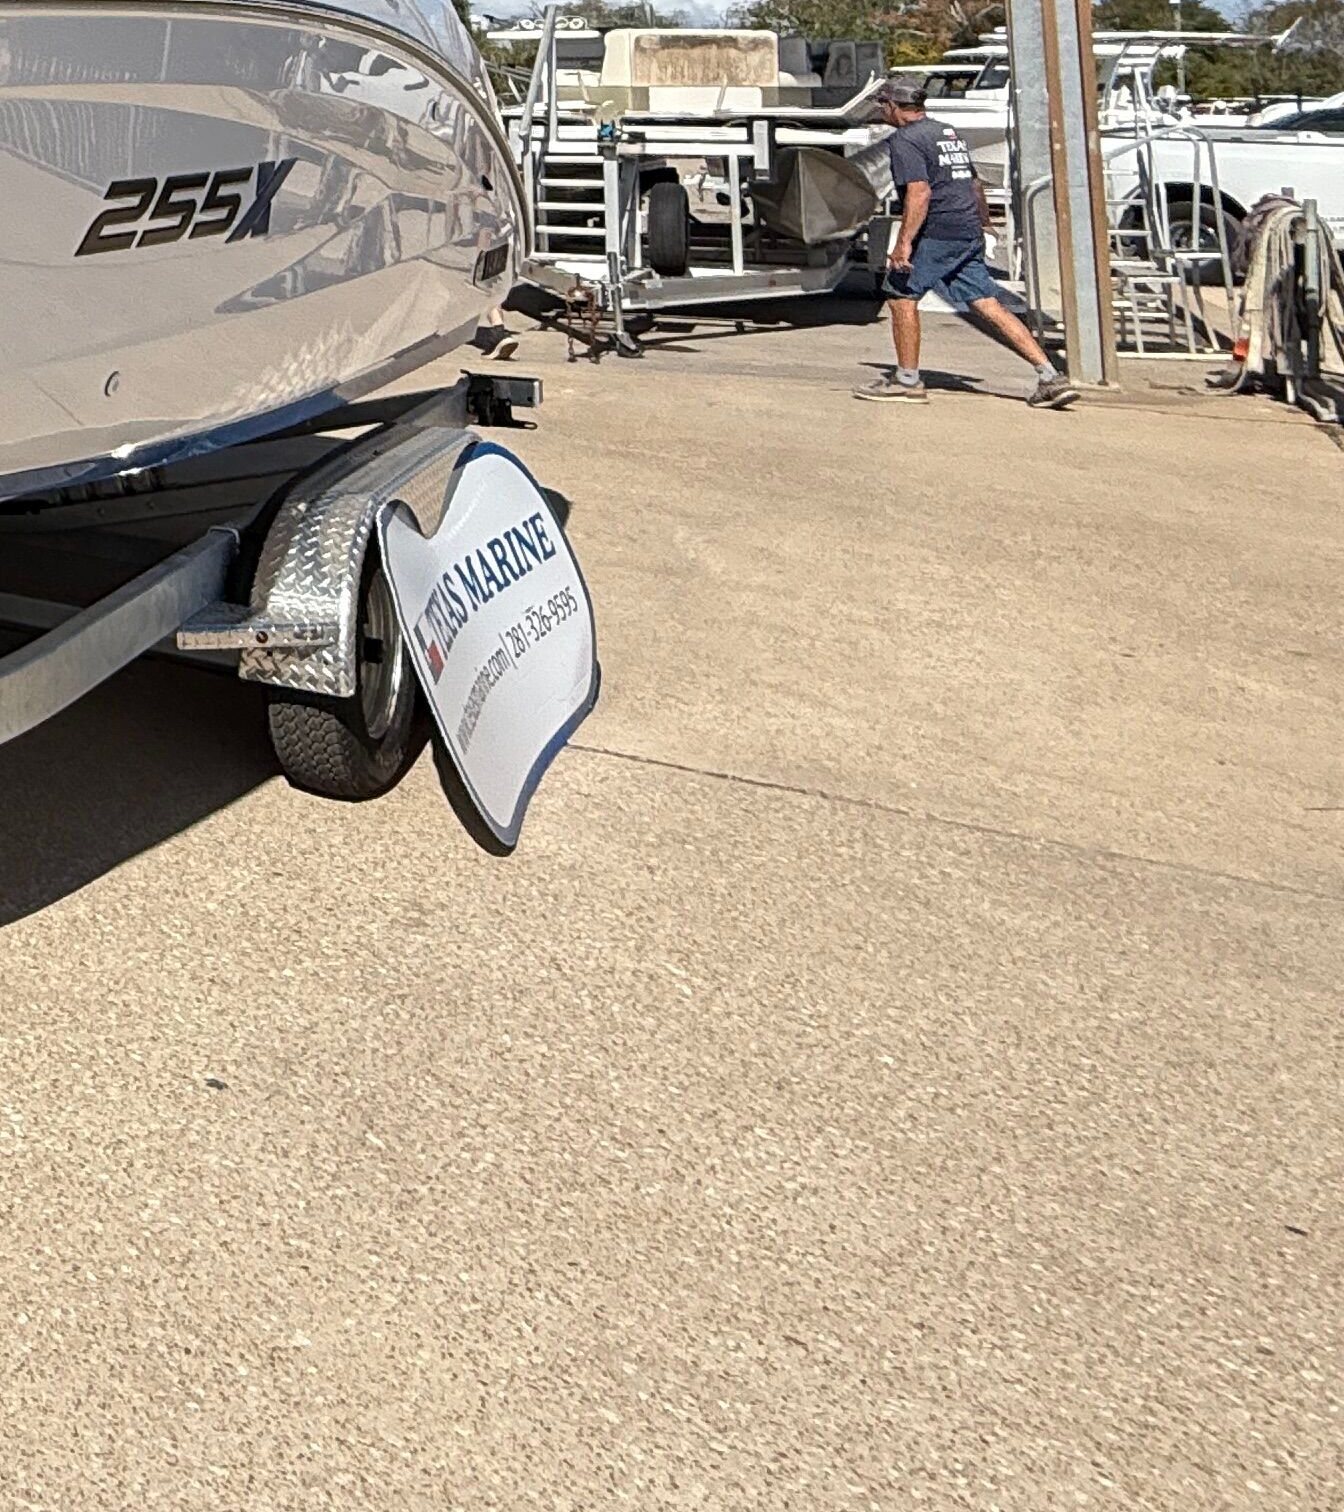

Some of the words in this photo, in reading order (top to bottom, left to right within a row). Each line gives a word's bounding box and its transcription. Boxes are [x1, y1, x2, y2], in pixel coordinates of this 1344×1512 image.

[73, 157, 298, 257] 255X
[424, 571, 468, 661] TEXAS
[453, 511, 557, 612] MARINE
[505, 585, 578, 659] 281-326-9595
